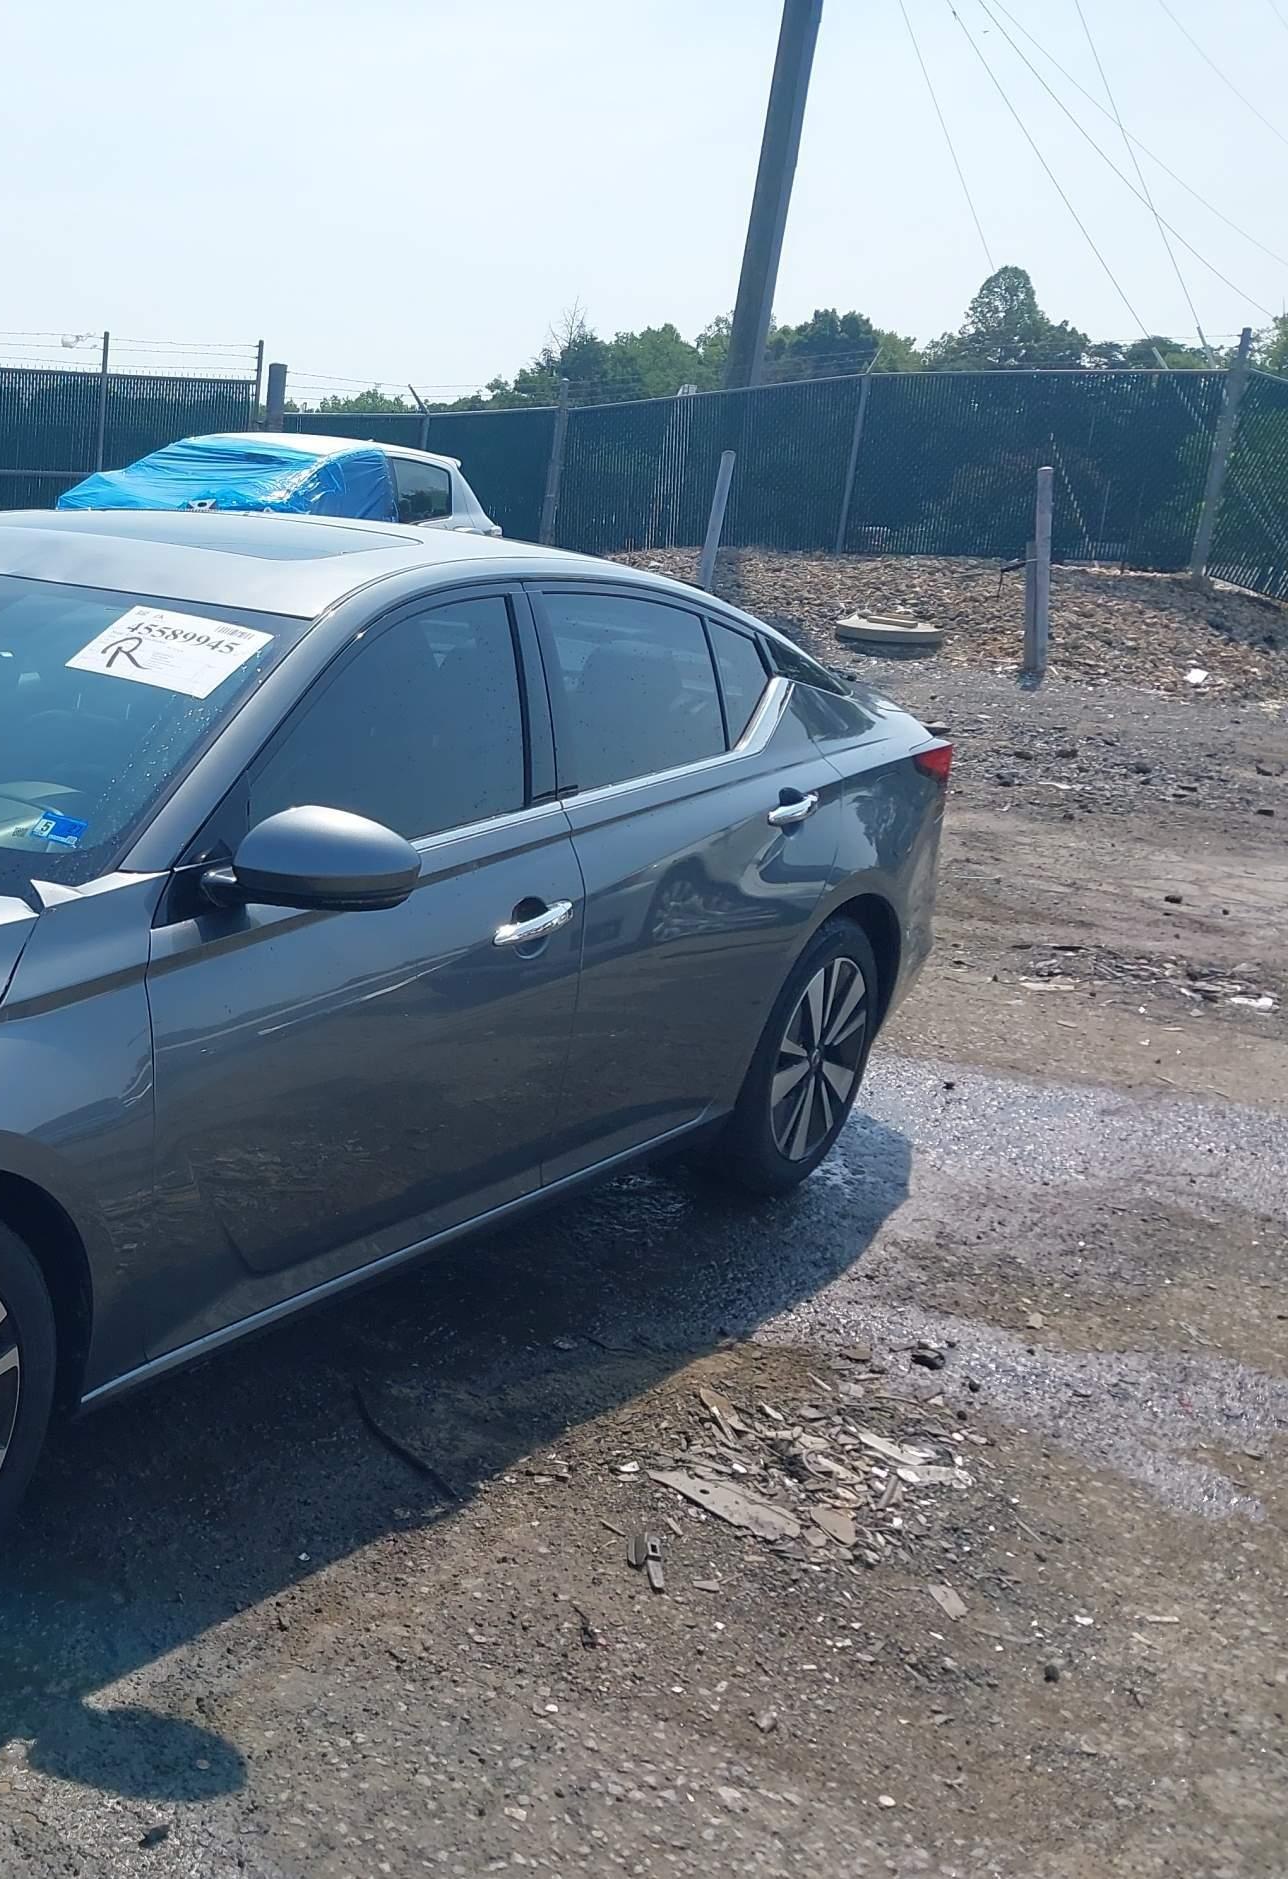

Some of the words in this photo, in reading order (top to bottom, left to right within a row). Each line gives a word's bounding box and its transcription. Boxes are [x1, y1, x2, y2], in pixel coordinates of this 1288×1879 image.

[100, 636, 152, 670] R
[127, 621, 241, 655] 45589945
[41, 821, 53, 832] 5
